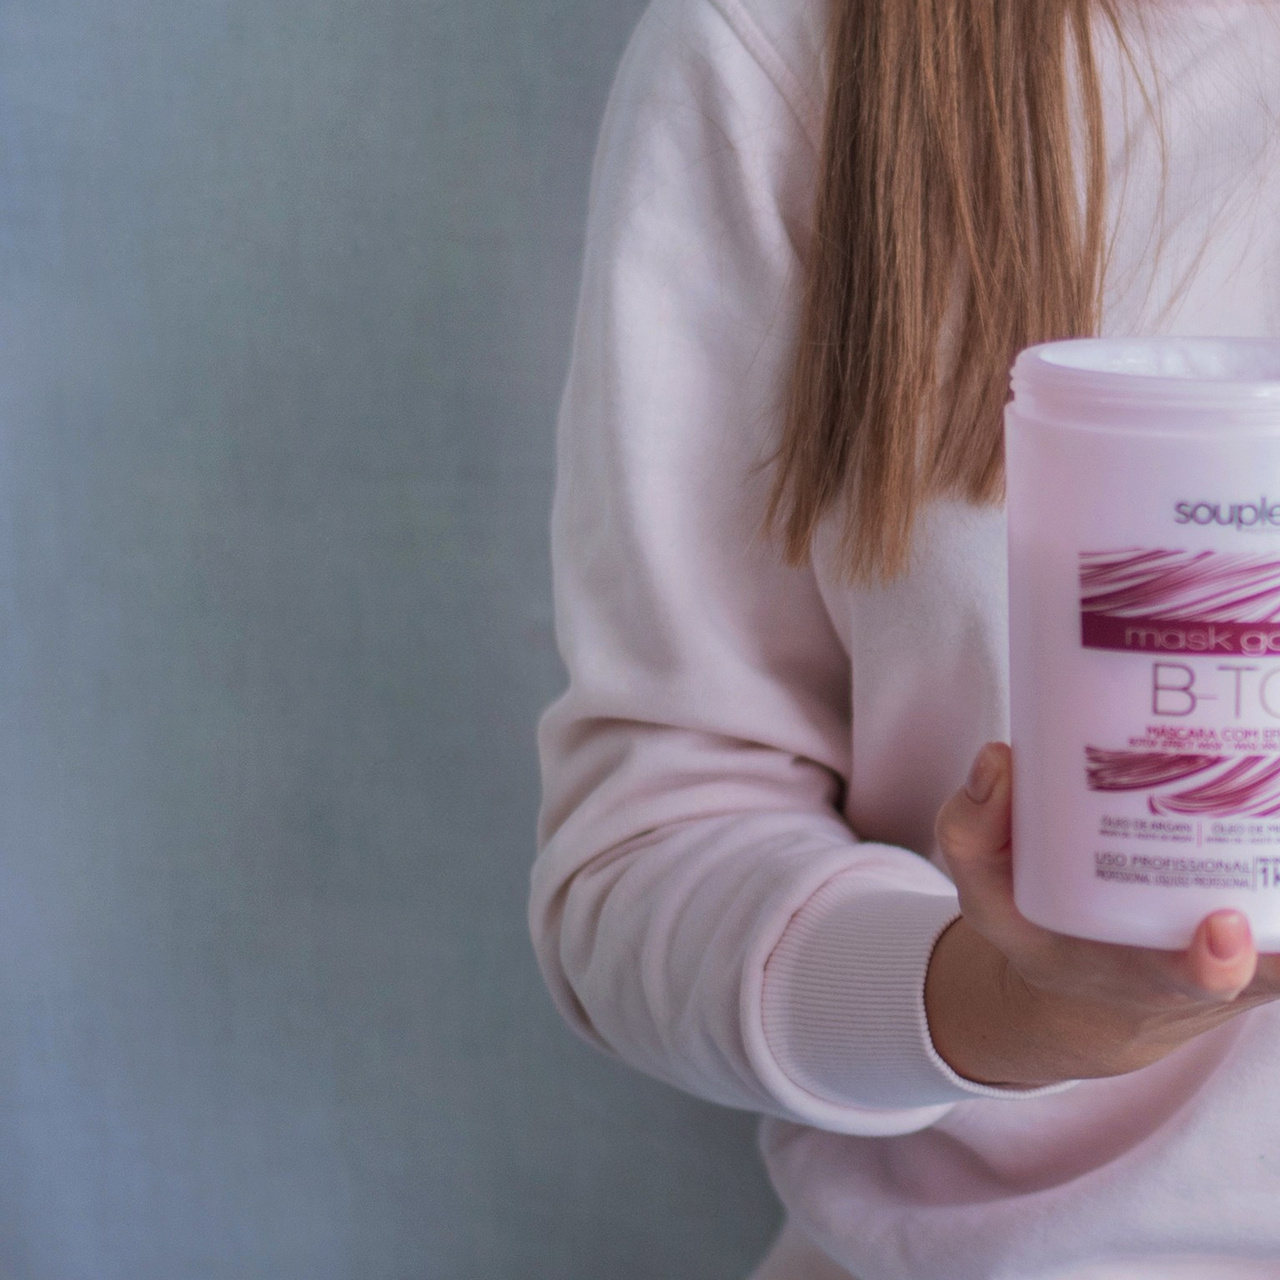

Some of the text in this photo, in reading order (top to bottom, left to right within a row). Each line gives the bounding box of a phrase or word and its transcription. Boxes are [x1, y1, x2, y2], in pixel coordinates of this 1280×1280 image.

[1124, 625, 1233, 652] mask
[1220, 726, 1258, 741] COM
[1094, 850, 1128, 867] USO
[1130, 854, 1250, 874] PROFISSIONAL
